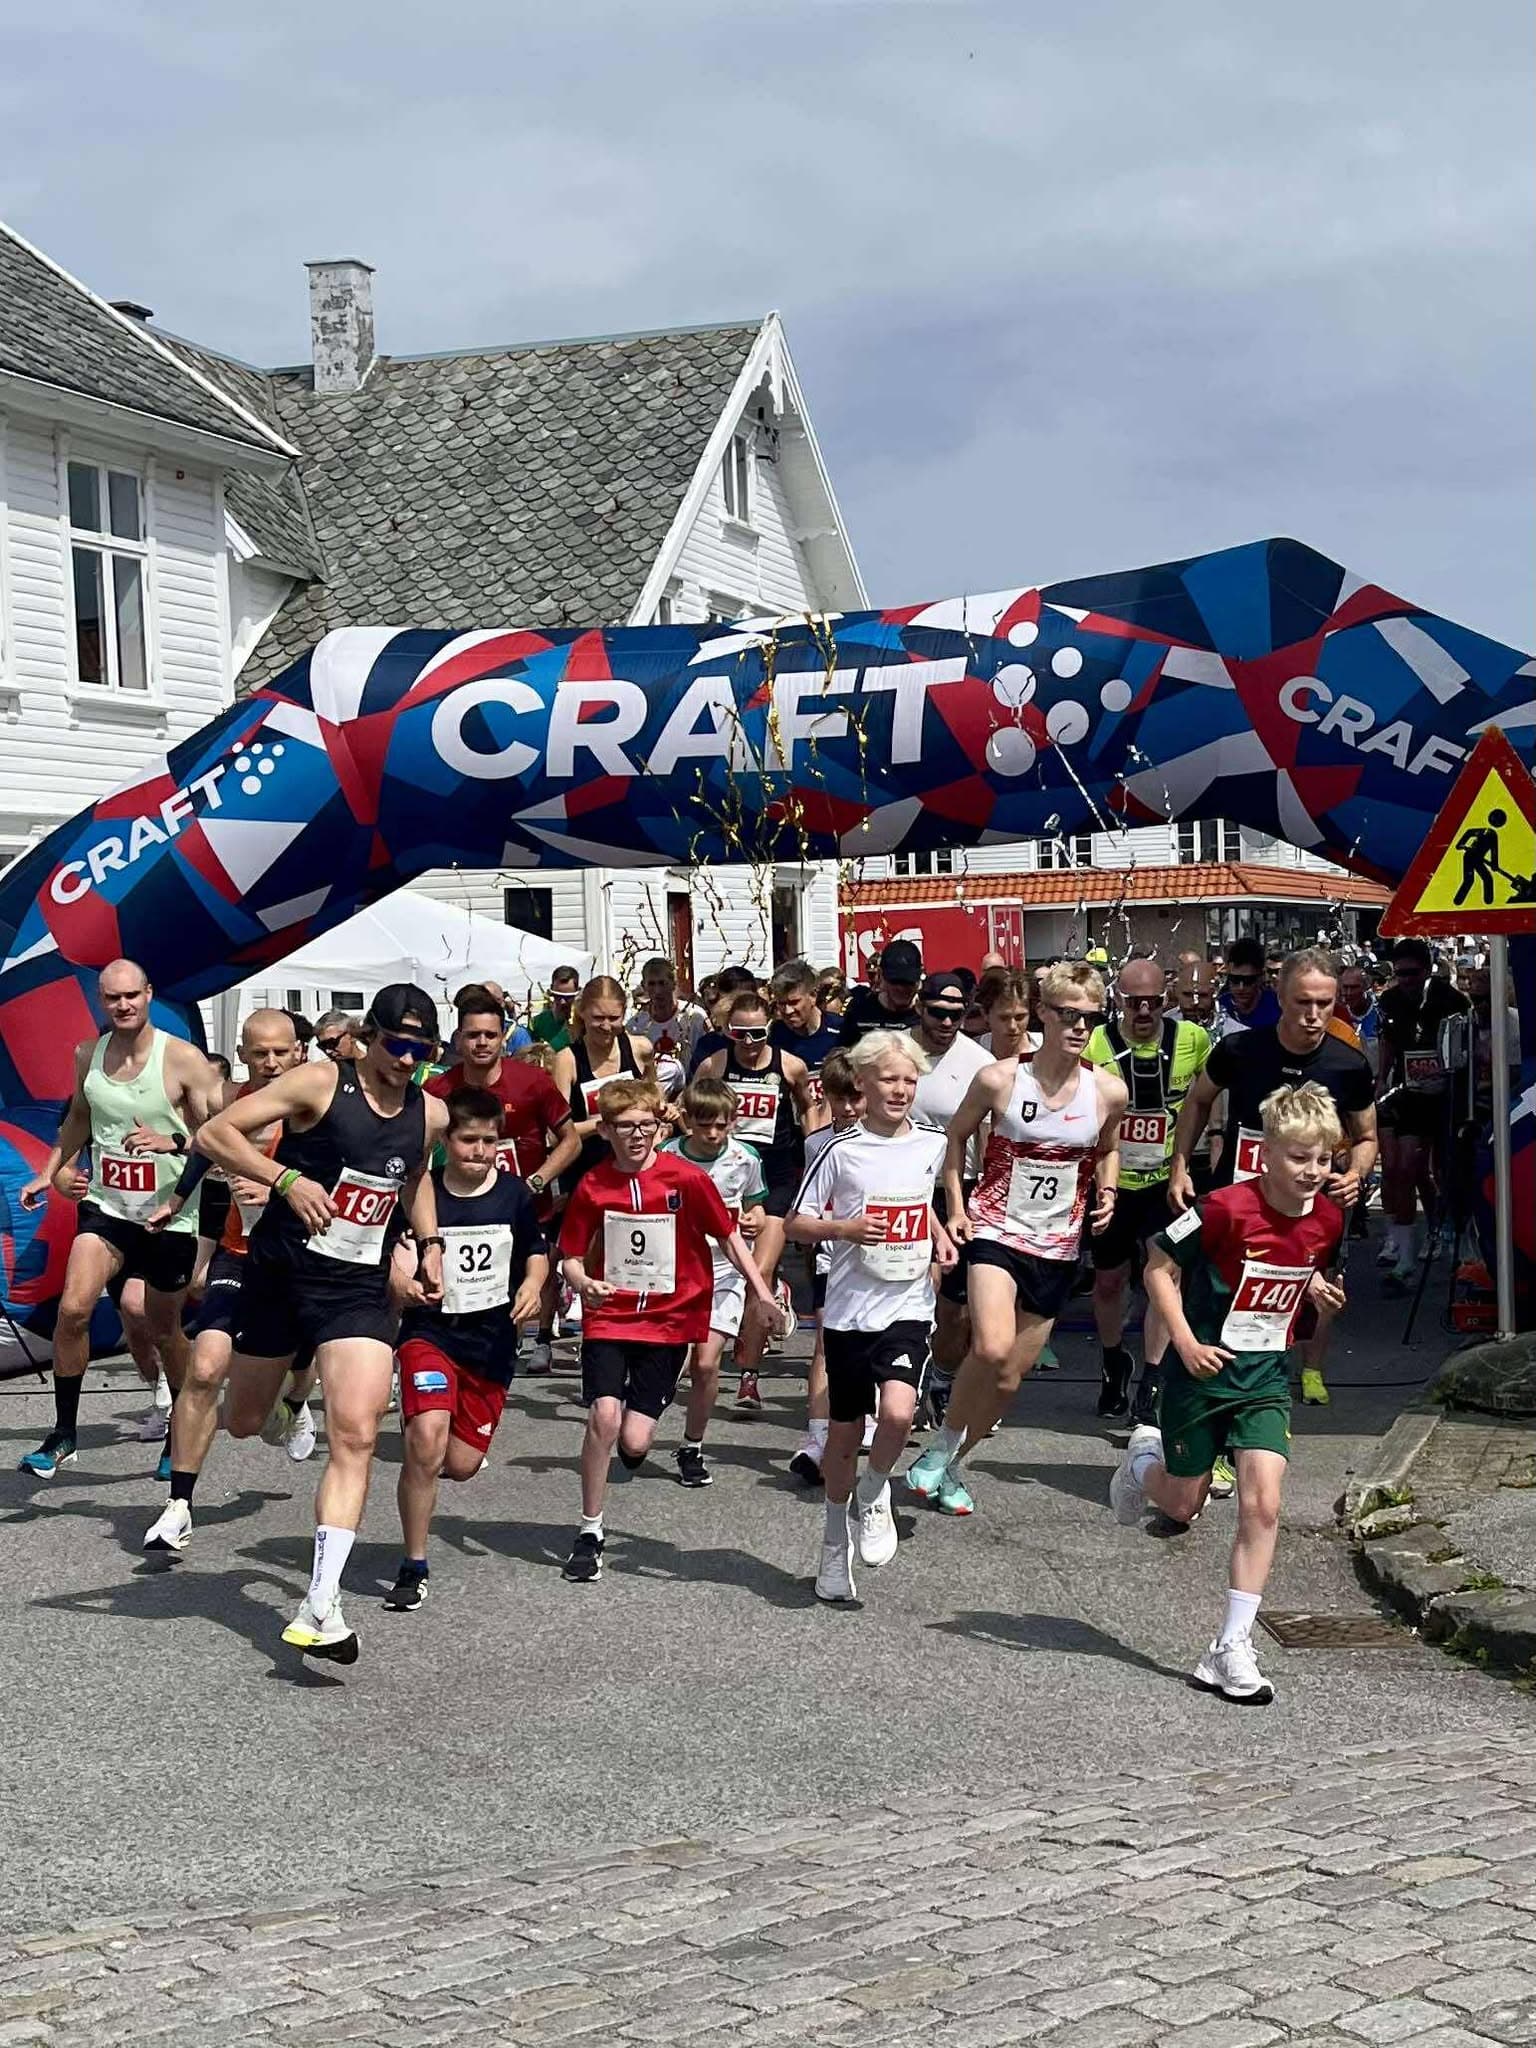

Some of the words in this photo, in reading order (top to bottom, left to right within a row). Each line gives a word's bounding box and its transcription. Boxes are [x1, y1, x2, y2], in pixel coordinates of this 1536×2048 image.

[431, 656, 967, 779] CRAFT
[1279, 676, 1476, 776] CRAF
[51, 764, 226, 904] CRAFT
[736, 1095, 770, 1117] 215
[1122, 1118, 1159, 1141] 188
[108, 1162, 144, 1189] 211
[1030, 1176, 1059, 1200] 73
[343, 1190, 391, 1223] 190
[631, 1230, 645, 1255] 9
[459, 1243, 492, 1272] 32
[1249, 1282, 1297, 1310] 140
